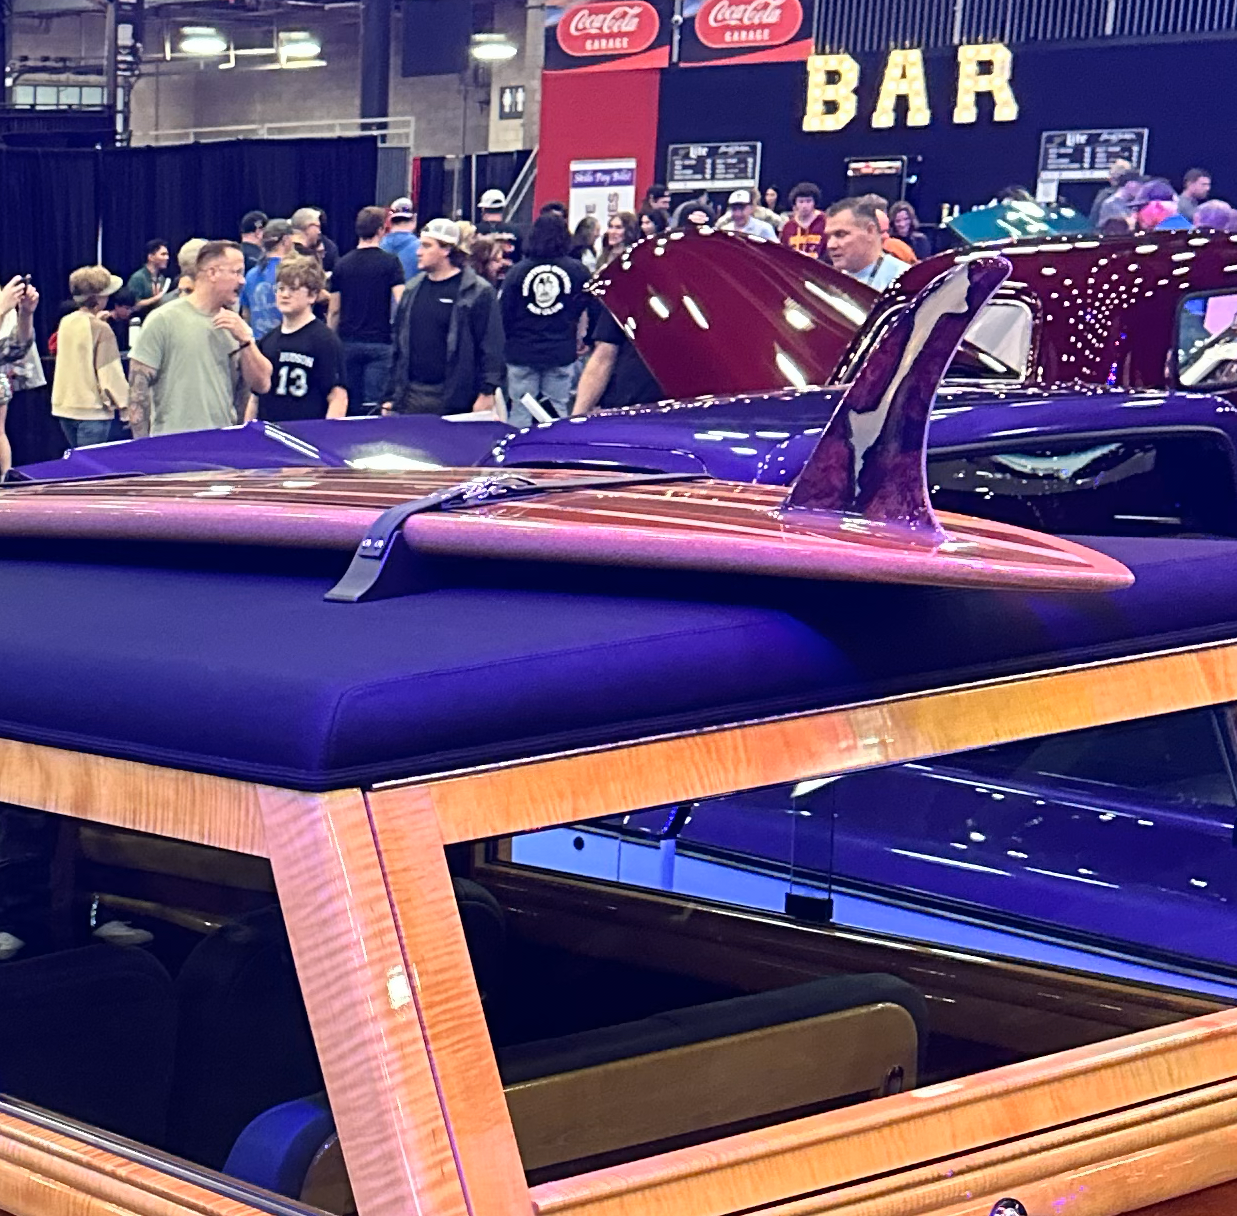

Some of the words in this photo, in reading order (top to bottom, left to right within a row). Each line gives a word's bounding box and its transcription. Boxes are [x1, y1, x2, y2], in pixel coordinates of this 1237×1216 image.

[585, 37, 629, 51] GARAGE
[724, 29, 770, 41] GARAGE
[802, 43, 1019, 132] BAR
[275, 366, 309, 397] 13
